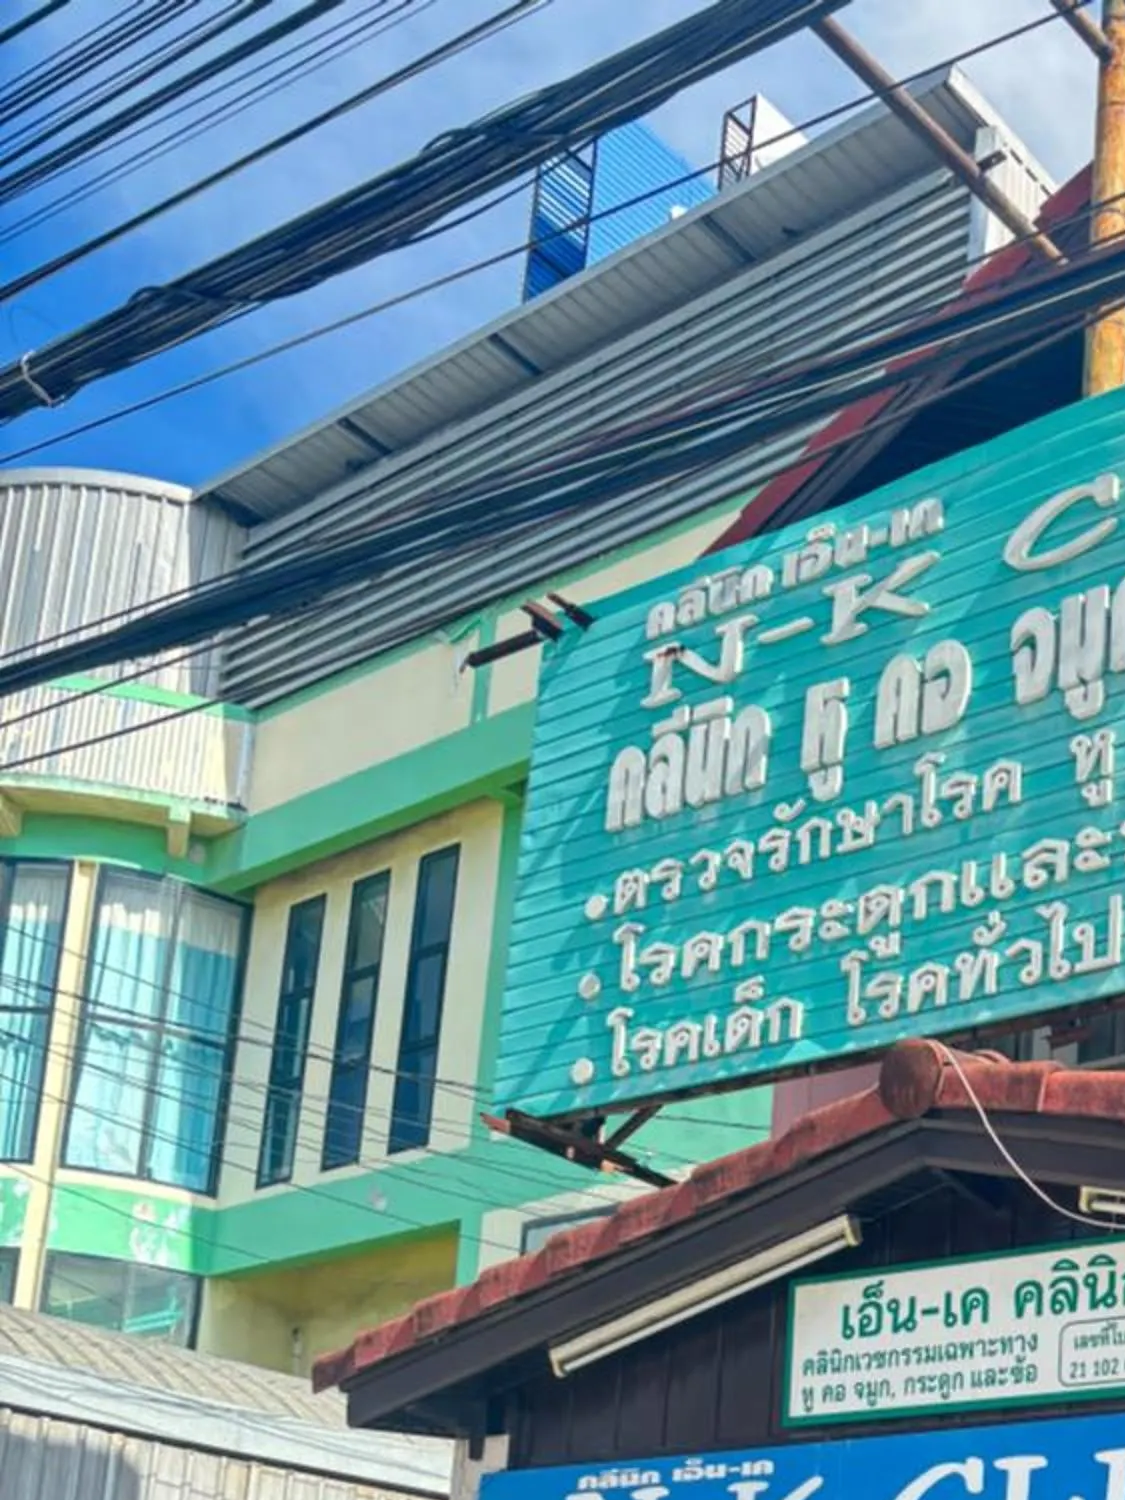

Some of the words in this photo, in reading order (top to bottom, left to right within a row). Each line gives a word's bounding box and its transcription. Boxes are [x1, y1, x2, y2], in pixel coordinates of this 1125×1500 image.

[641, 550, 941, 709] N-K
[801, 677, 850, 802] หู
[873, 639, 973, 750] คอ
[612, 751, 1024, 915] ตรวจรักษาโรค
[1069, 729, 1116, 807] หู
[606, 974, 803, 1077] โรคเด็ก
[841, 893, 1123, 1025] โรคทั่วไป
[801, 1332, 1039, 1377] คลินิกเวชกรรมเฉพาะทาง
[841, 1279, 990, 1341] เอ็น-เค
[801, 1386, 814, 1412] หู
[822, 1384, 847, 1403] คอ
[853, 1380, 897, 1406] จมูก,
[903, 1370, 965, 1400] กระดูก
[970, 1355, 1039, 1389] และข้อ
[1093, 1357, 1120, 1377] 102
